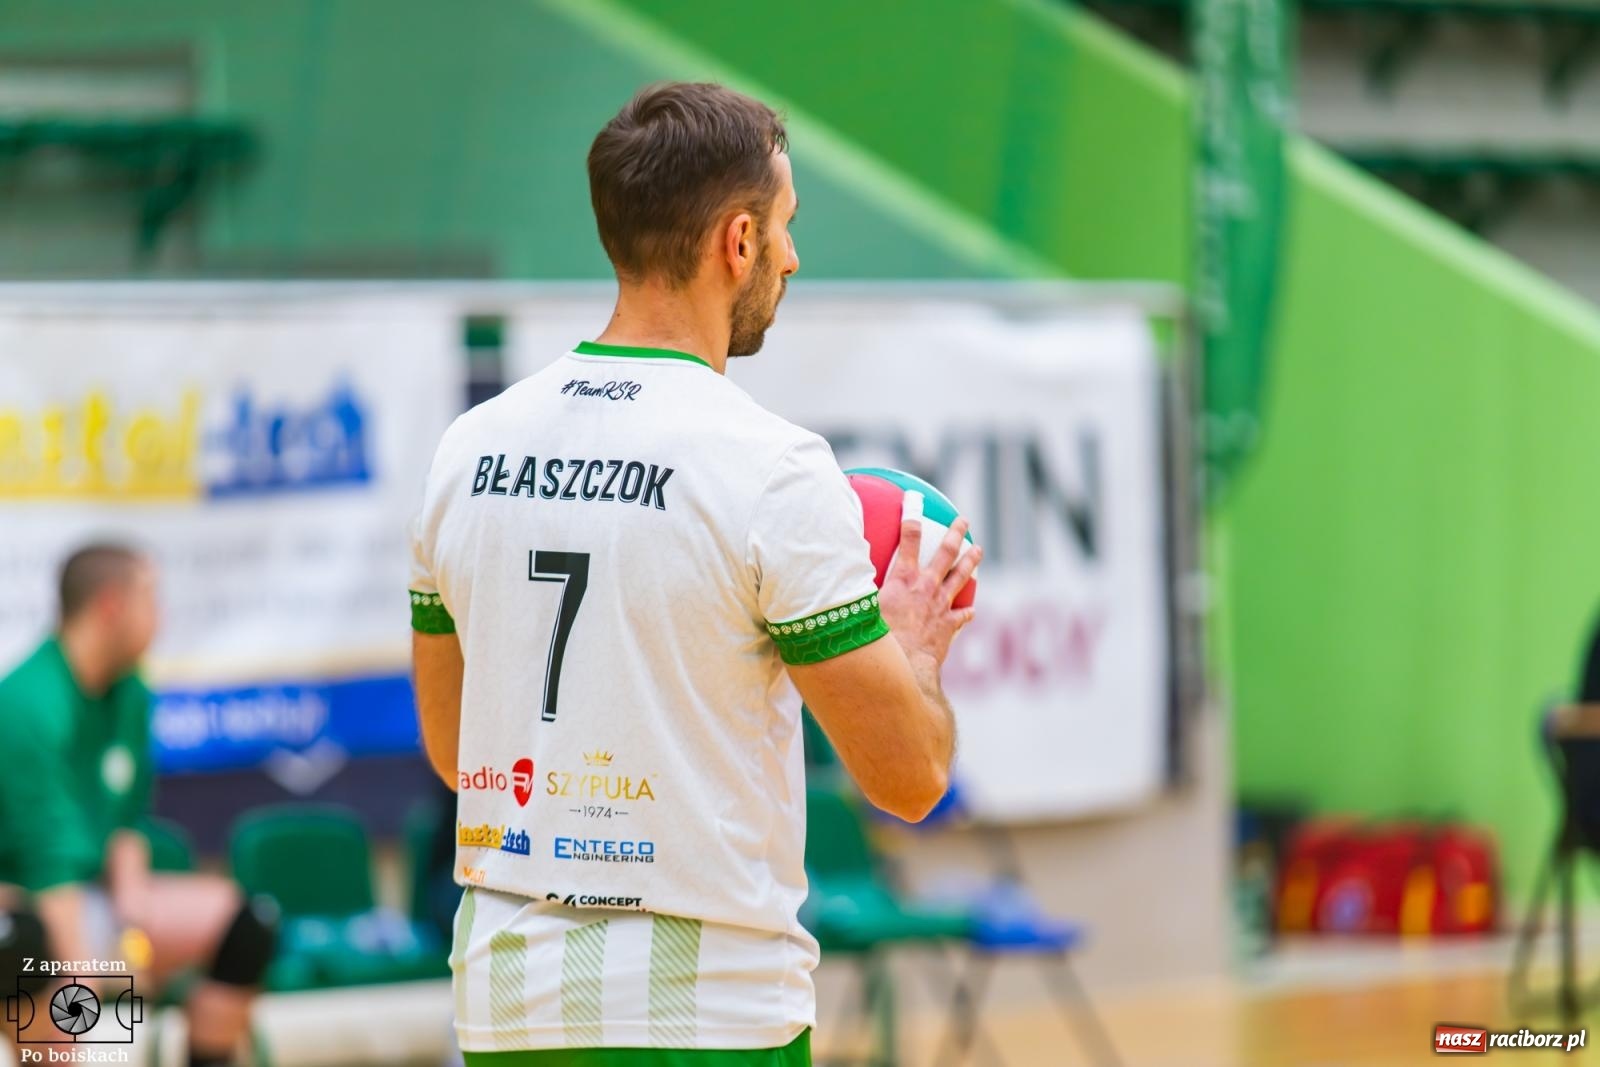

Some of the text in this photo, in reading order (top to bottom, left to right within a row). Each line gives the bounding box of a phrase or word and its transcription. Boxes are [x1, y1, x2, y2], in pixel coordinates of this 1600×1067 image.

[471, 454, 675, 511] BŁASZCZOK
[528, 549, 591, 722] 7
[458, 765, 508, 791] adio
[546, 771, 655, 801] SZYPUŁA
[583, 805, 612, 819] 1974
[554, 837, 655, 859] ENTECO
[579, 895, 642, 907] CONCEPT
